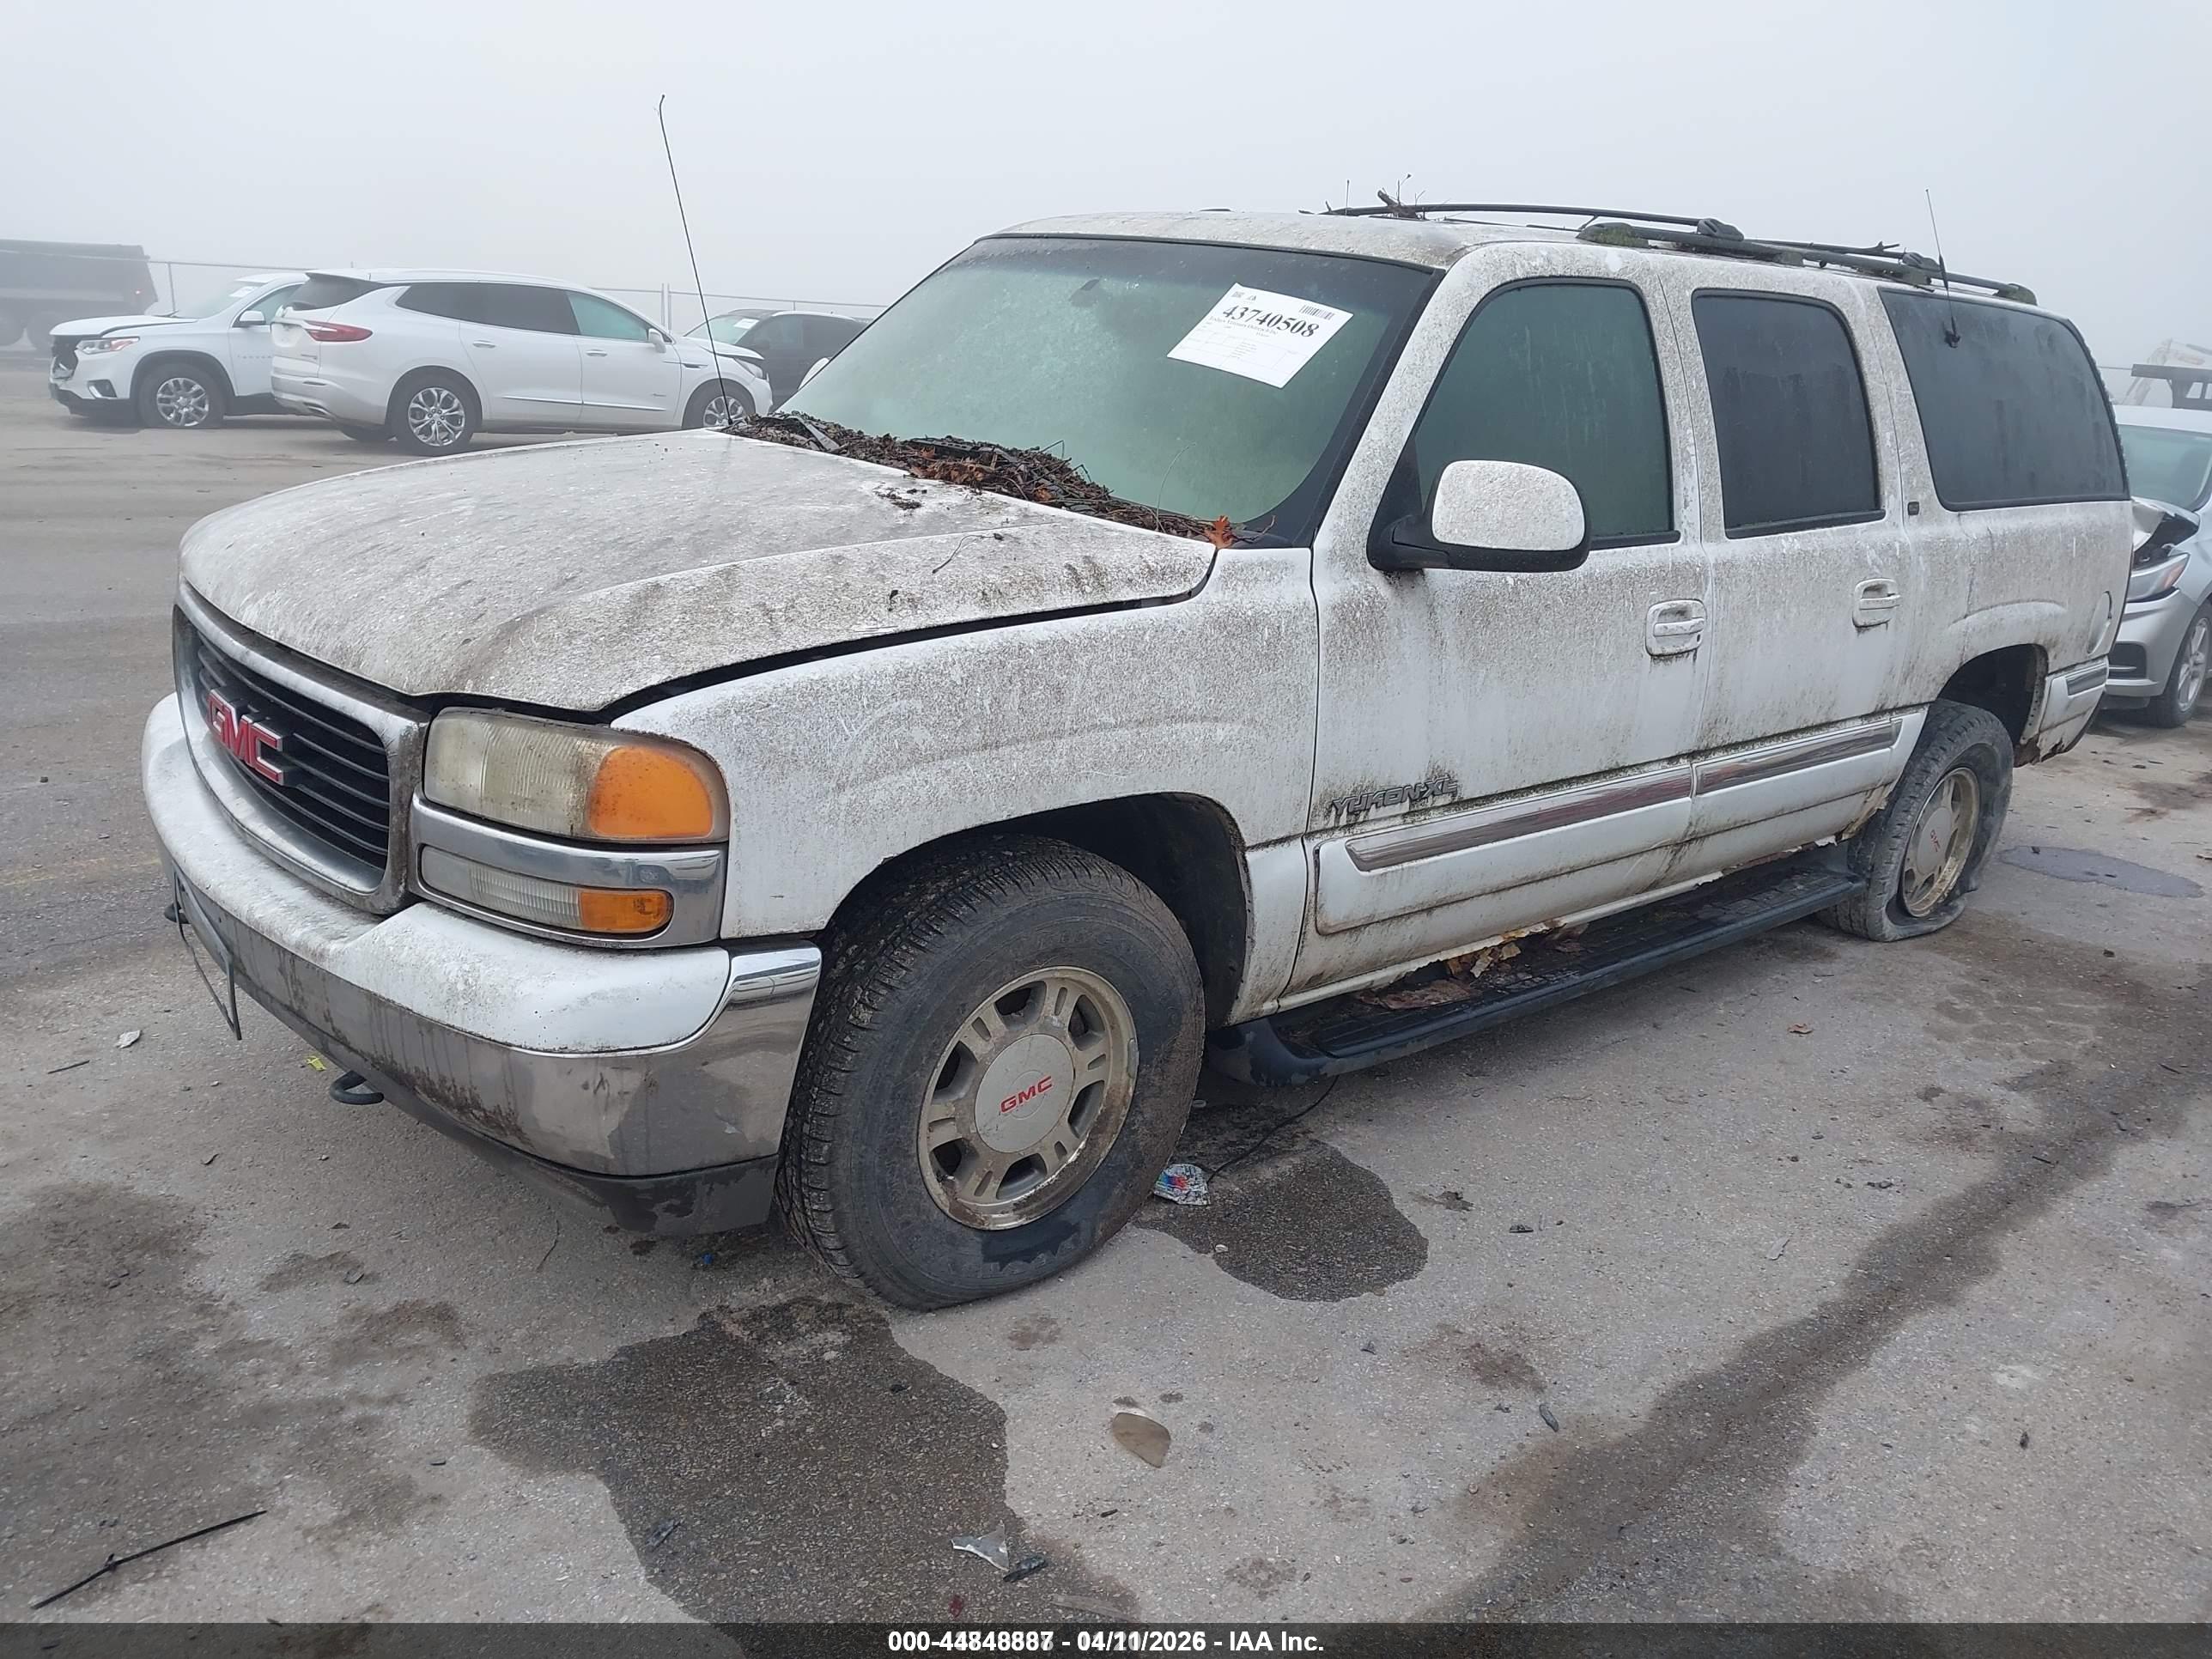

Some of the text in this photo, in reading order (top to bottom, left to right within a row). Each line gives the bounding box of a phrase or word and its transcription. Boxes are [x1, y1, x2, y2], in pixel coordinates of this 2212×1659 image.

[1223, 304, 1320, 337] 43740508
[208, 689, 284, 786] GMC
[1333, 775, 1458, 815] YUKON XL
[1000, 1075, 1054, 1114] GMC
